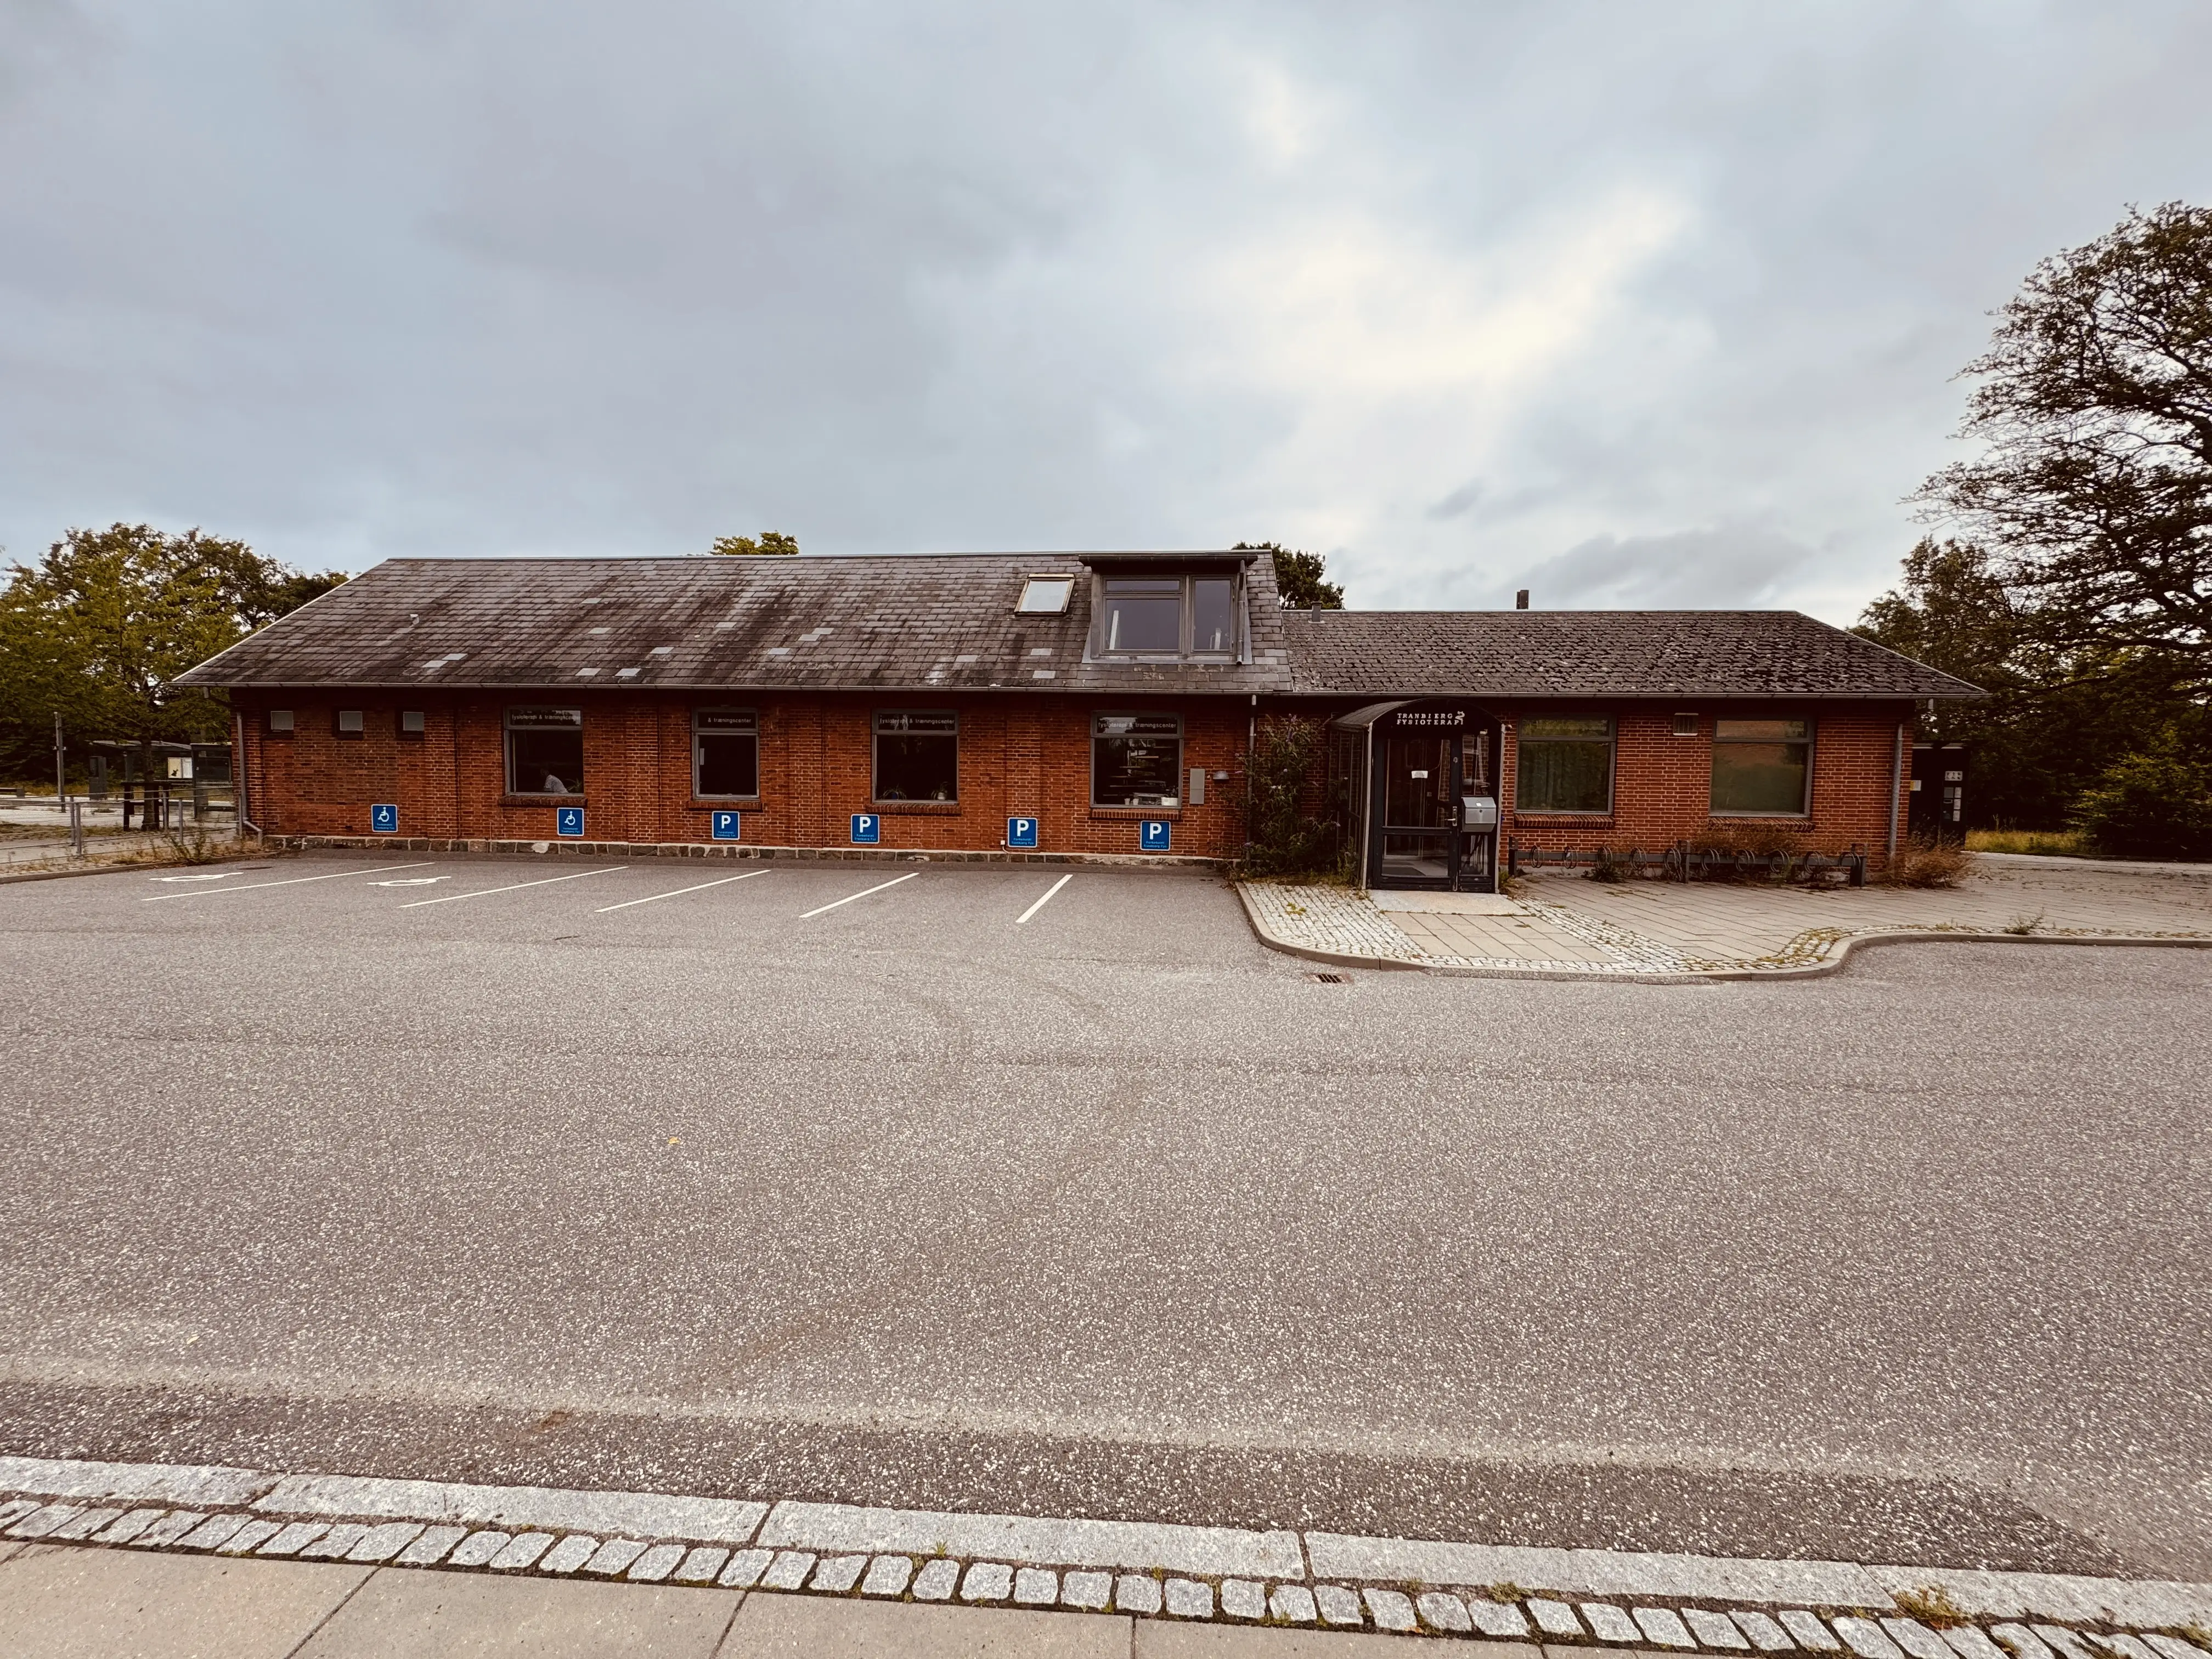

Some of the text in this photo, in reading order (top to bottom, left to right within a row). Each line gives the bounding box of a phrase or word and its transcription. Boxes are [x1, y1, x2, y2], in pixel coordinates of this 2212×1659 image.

[721, 815, 731, 828] P
[860, 816, 871, 833] P
[1017, 820, 1029, 837] P
[1149, 823, 1162, 839] P
